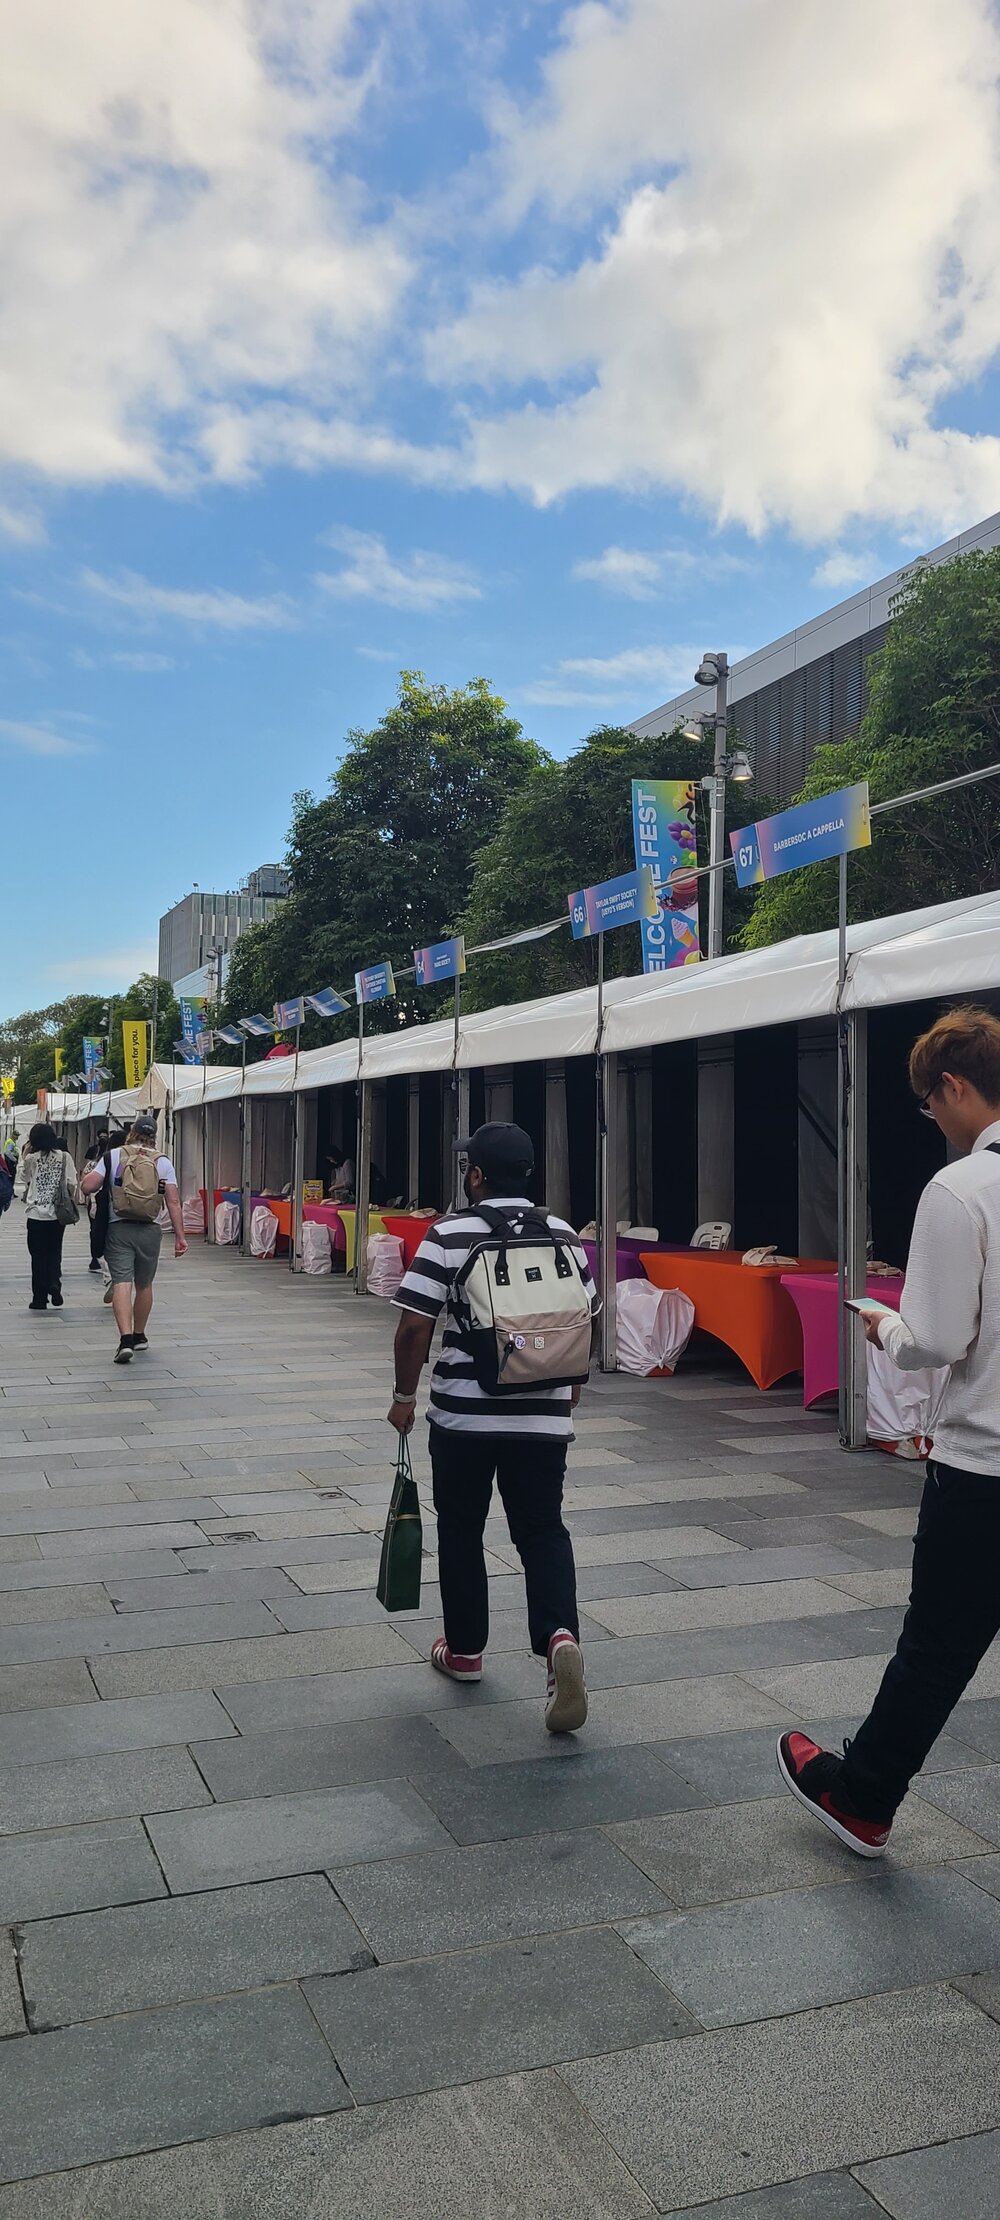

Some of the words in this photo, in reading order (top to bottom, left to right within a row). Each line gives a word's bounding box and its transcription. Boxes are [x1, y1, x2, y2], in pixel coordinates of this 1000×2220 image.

[638, 790, 660, 858] FEST
[773, 832, 807, 852] BARBERSOC
[807, 831, 813, 840] A
[813, 818, 845, 838] CAPPELLA
[739, 845, 753, 868] 67
[609, 893, 620, 904] SWIFT
[621, 889, 637, 899] SOCIETY
[616, 898, 635, 909] VERSION)
[573, 905, 584, 924] 66
[182, 1000, 193, 1028] FEST
[132, 1028, 140, 1045] you.
[131, 1047, 139, 1058] for
[133, 1060, 141, 1081] place
